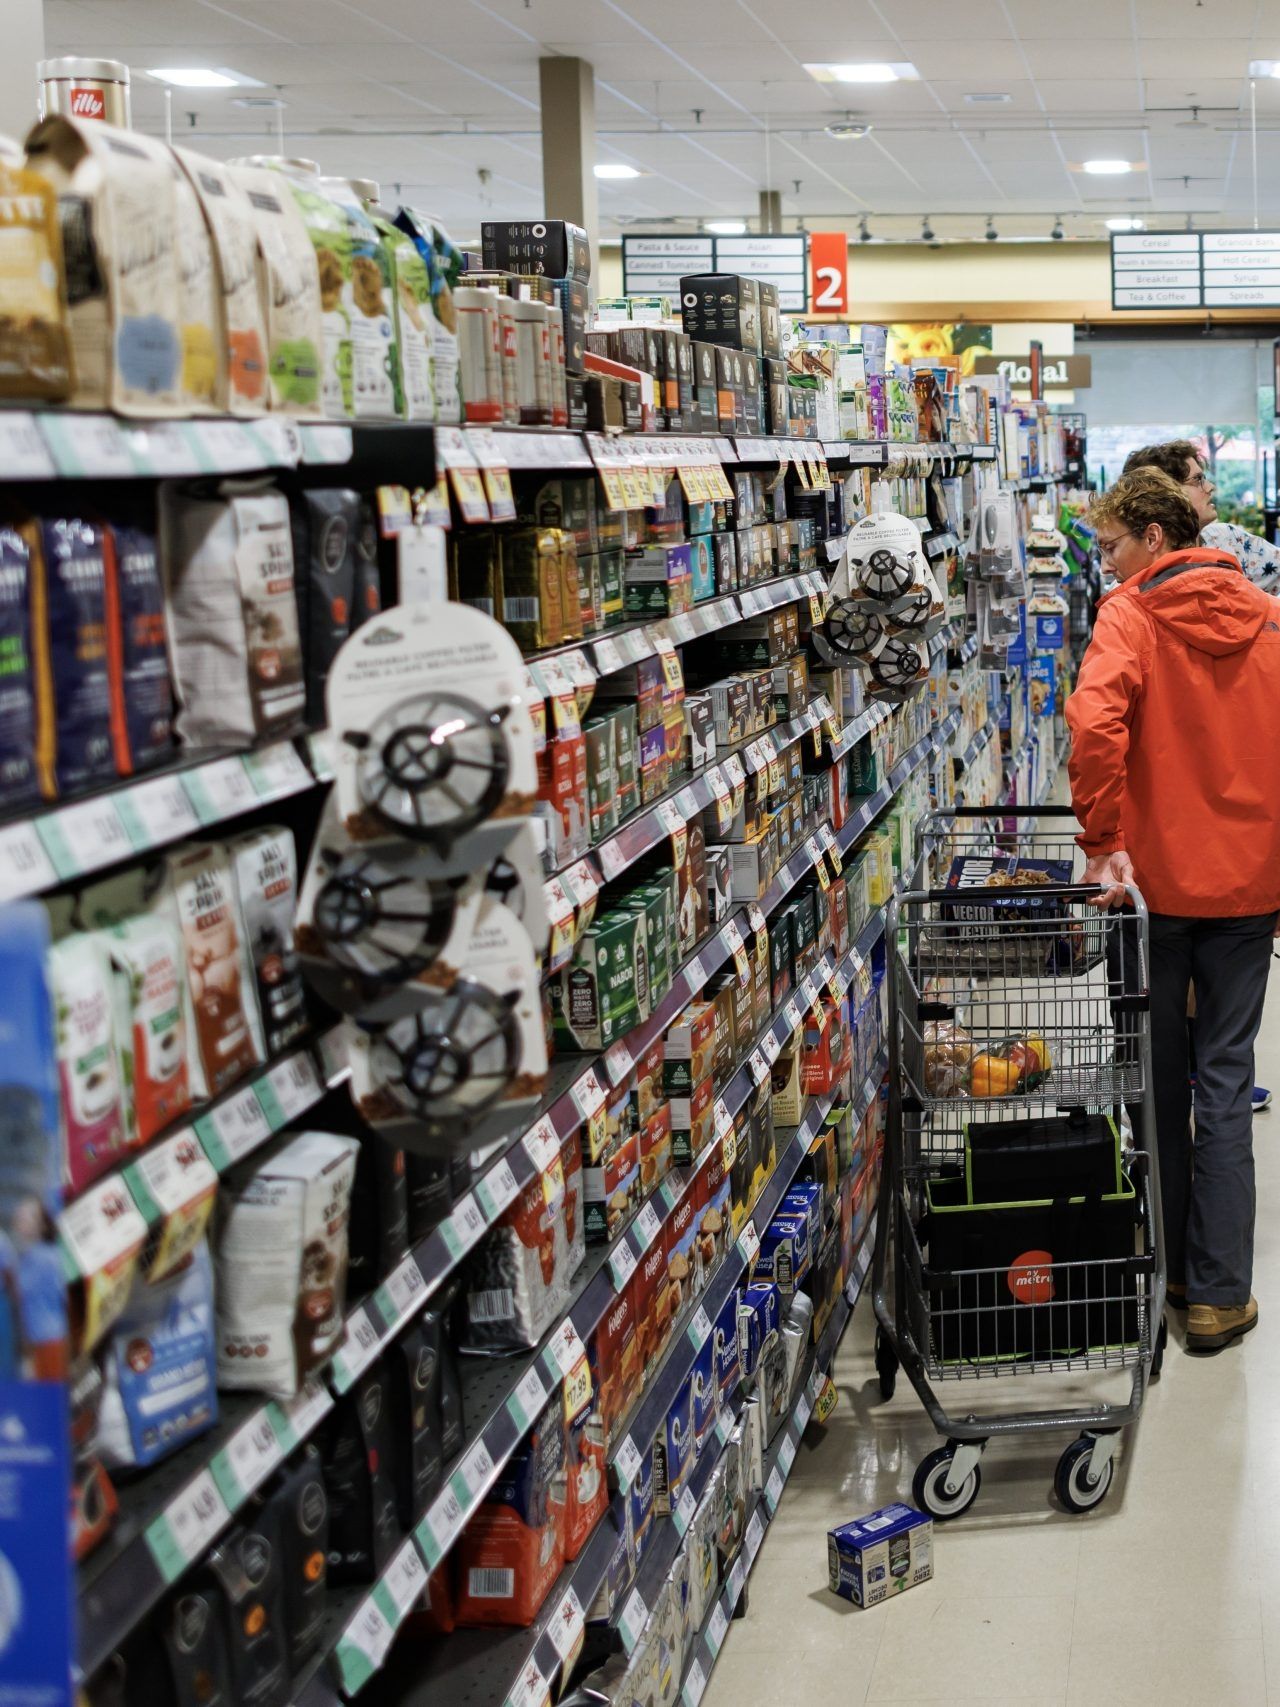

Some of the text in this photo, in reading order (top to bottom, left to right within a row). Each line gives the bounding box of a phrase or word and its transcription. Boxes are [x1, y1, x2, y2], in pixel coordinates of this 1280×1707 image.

[73, 93, 102, 117] illy
[638, 242, 700, 251] Pasta & Sauce
[748, 242, 772, 251] Asian
[1142, 239, 1170, 248] Cereal
[1218, 238, 1274, 247] Granola Bars
[629, 261, 710, 270] Canned Tomatoes
[751, 261, 768, 270] Rice
[1223, 255, 1270, 264] Hot Cereal
[1136, 274, 1179, 283] Breakfast
[1233, 273, 1259, 284] Syrup
[816, 267, 843, 307] 2
[1129, 291, 1186, 301] Tea & Coffee
[1230, 291, 1264, 302] Spreads
[997, 361, 1068, 383] floal
[958, 860, 994, 889] CTOR
[952, 905, 995, 921] VECTOR
[959, 926, 1000, 941] VECTOR
[610, 967, 633, 988] NABOB
[574, 999, 592, 1007] ZÉRO
[652, 1126, 664, 1143] Folgers
[618, 1160, 631, 1178] Folgers
[708, 1160, 725, 1188] Folgers
[674, 1201, 690, 1233] Folgers
[645, 1247, 662, 1281] Folgers
[758, 1256, 773, 1267] well
[1016, 1274, 1053, 1285] metro
[609, 1300, 627, 1336] Folgers
[722, 1332, 737, 1371] Maxwell House
[913, 1569, 931, 1582] ZERO
[915, 1564, 930, 1575] WASTE
